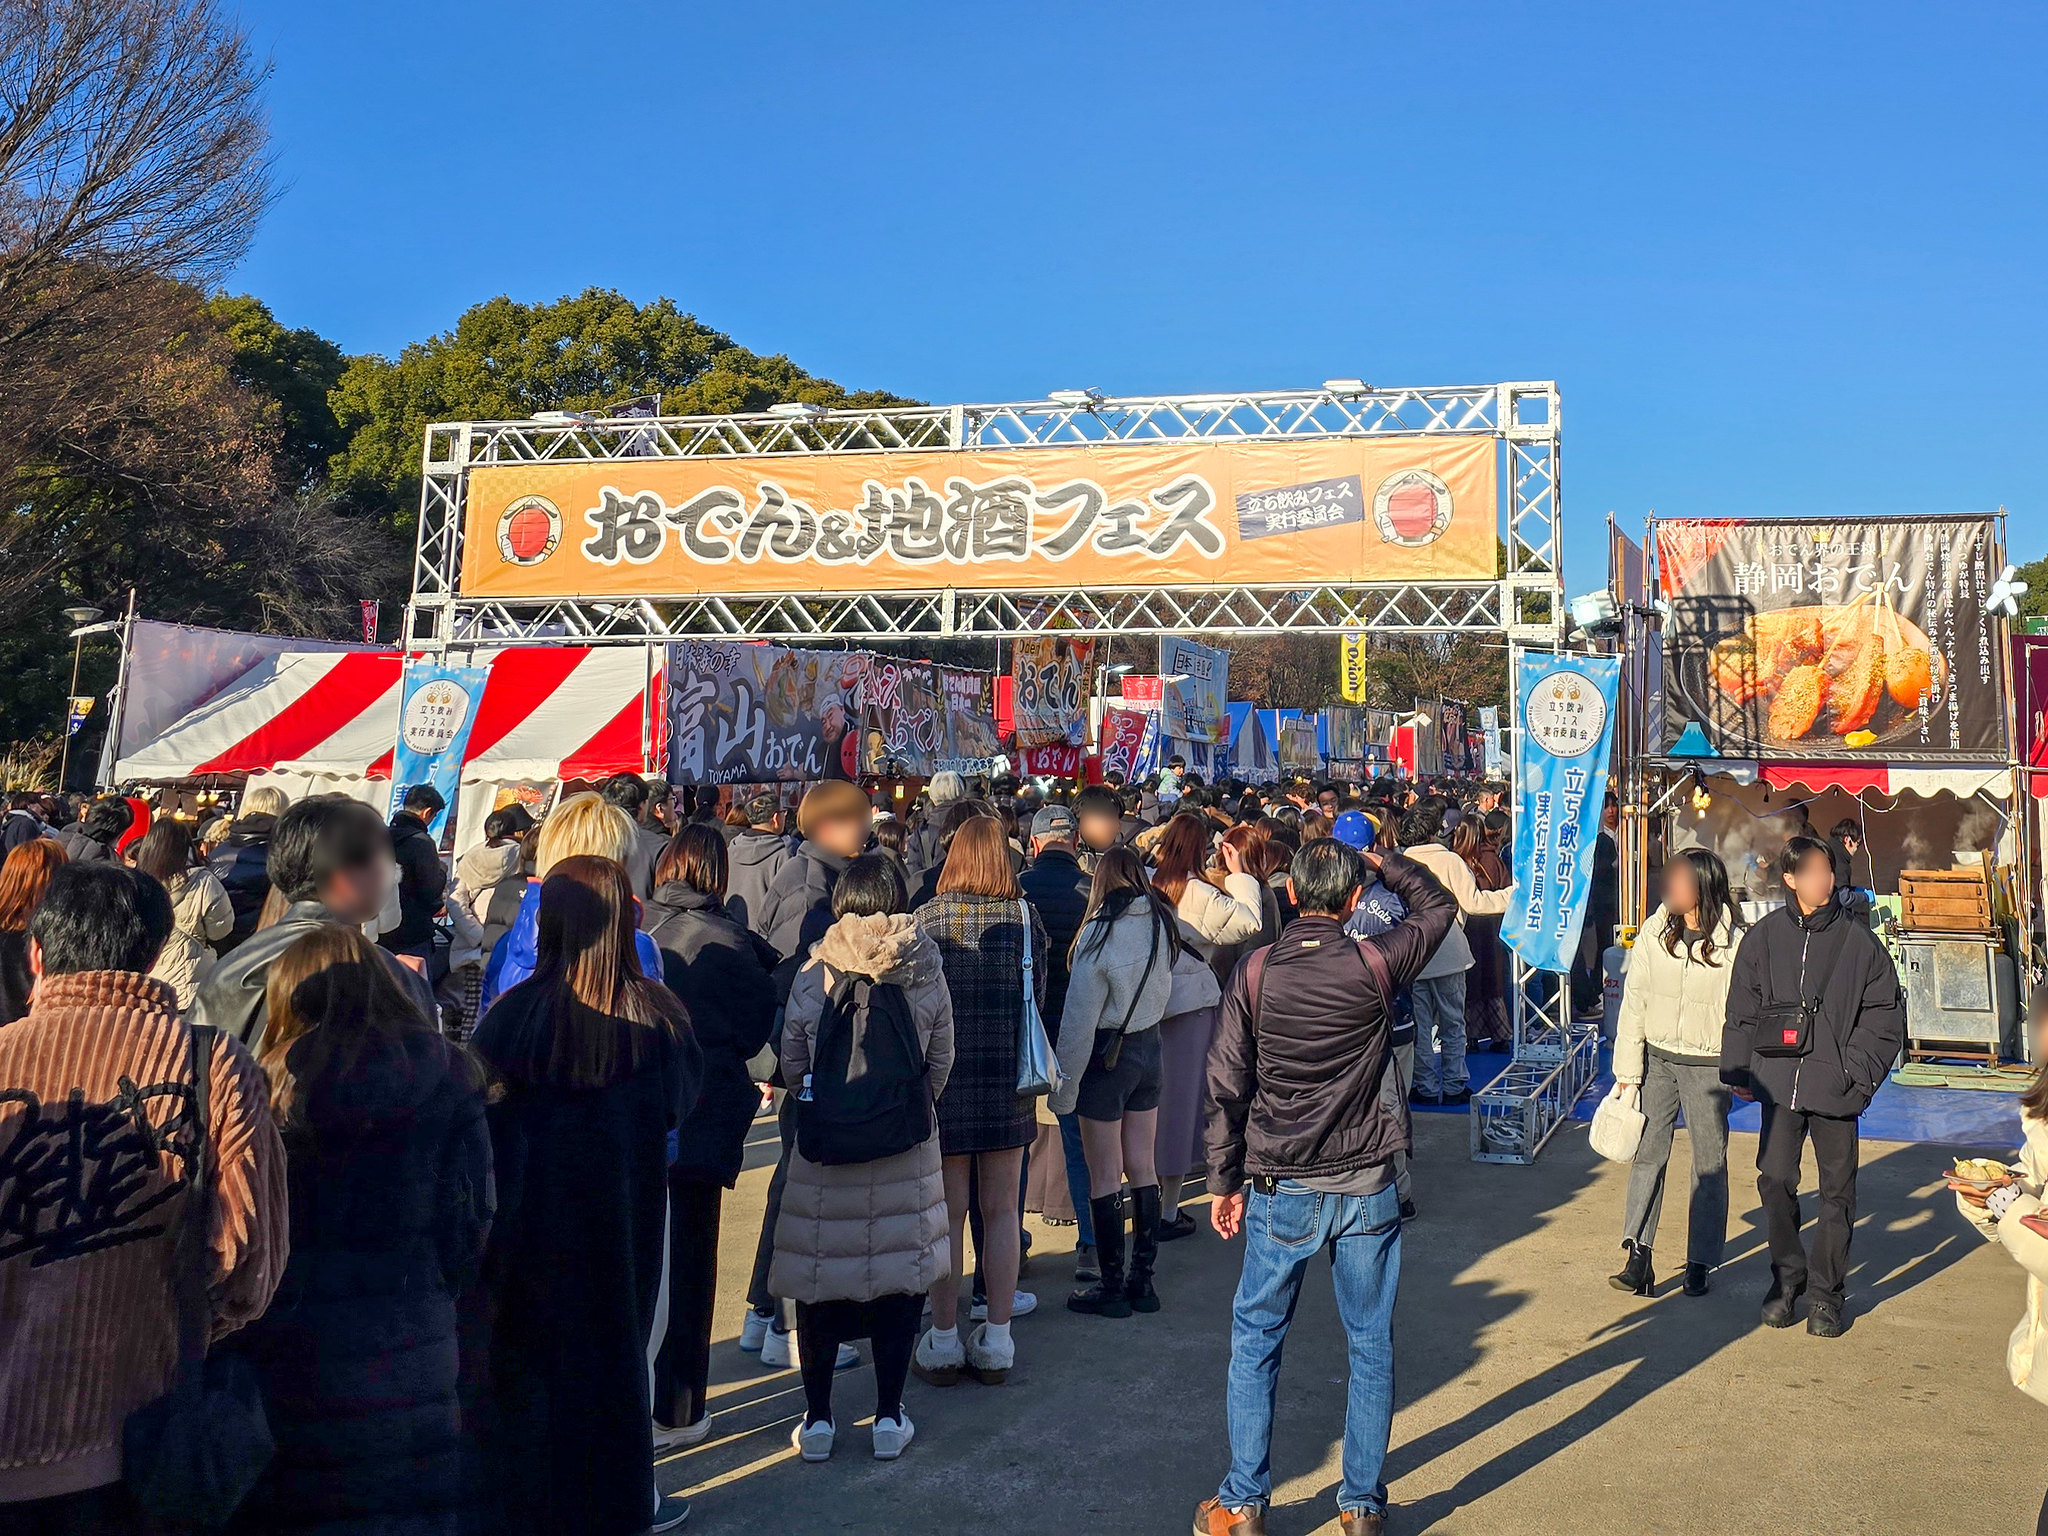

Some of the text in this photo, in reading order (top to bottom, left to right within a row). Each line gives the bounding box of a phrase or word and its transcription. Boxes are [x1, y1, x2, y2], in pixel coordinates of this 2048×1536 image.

[1247, 481, 1354, 514] 立ち飲みフェス
[582, 474, 1228, 566] おでん&地酒フェス
[1265, 502, 1345, 532] 実行委員会
[1769, 542, 1876, 558] おでん界の王様
[1732, 561, 1916, 596] 静岡おでん
[675, 644, 742, 677] 日本海の幸
[1018, 657, 1081, 713] おでん
[420, 705, 453, 716] 立ち飲み
[1549, 701, 1583, 713] 立ち飲み
[1554, 714, 1577, 726] フェス
[410, 727, 454, 739] 実行委員会
[423, 716, 446, 726] フェス
[1543, 726, 1588, 741] 実行委員会
[708, 763, 747, 784] TOYAMA
[1527, 793, 1551, 931] 実行委員会
[1555, 768, 1586, 938] 立ち飲みフェ
[1367, 899, 1392, 925] State
